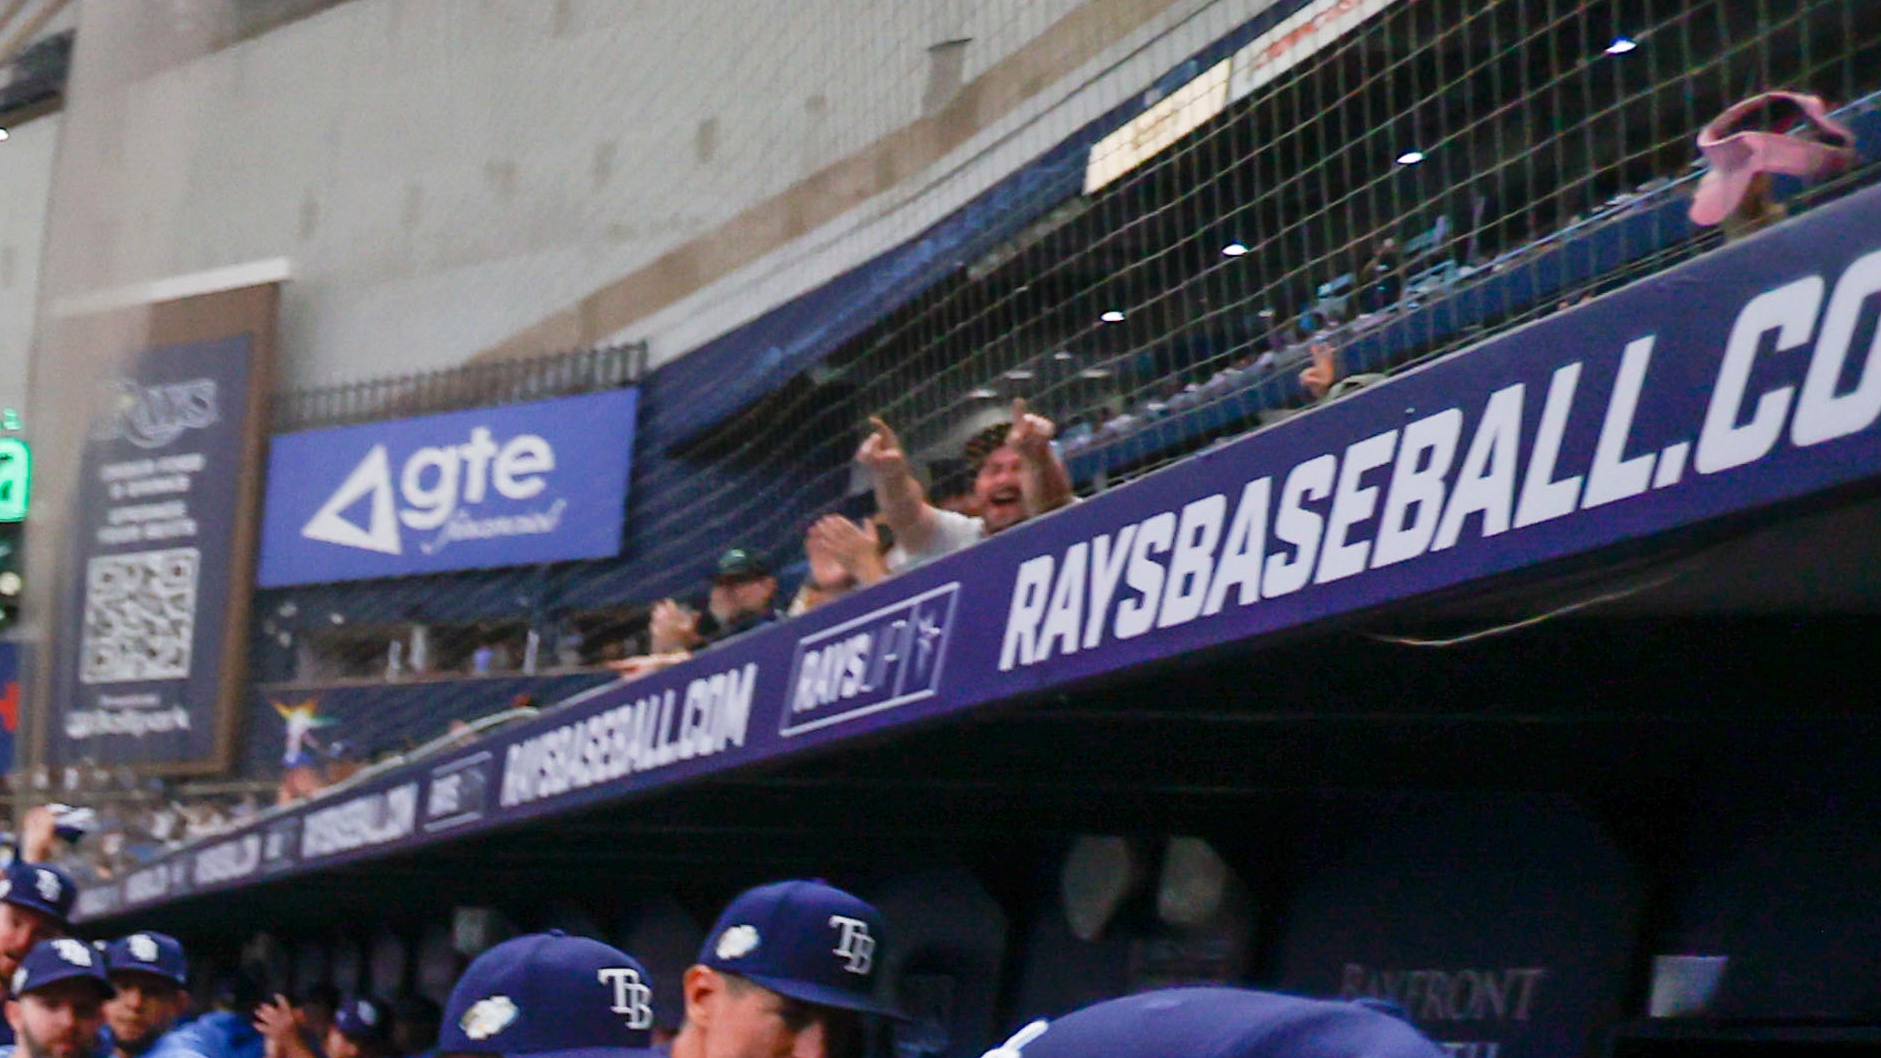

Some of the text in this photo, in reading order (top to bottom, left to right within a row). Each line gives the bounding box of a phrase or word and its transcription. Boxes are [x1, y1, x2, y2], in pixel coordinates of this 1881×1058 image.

[399, 426, 556, 531] gte
[830, 915, 876, 975] TB
[597, 967, 654, 1031] TB
